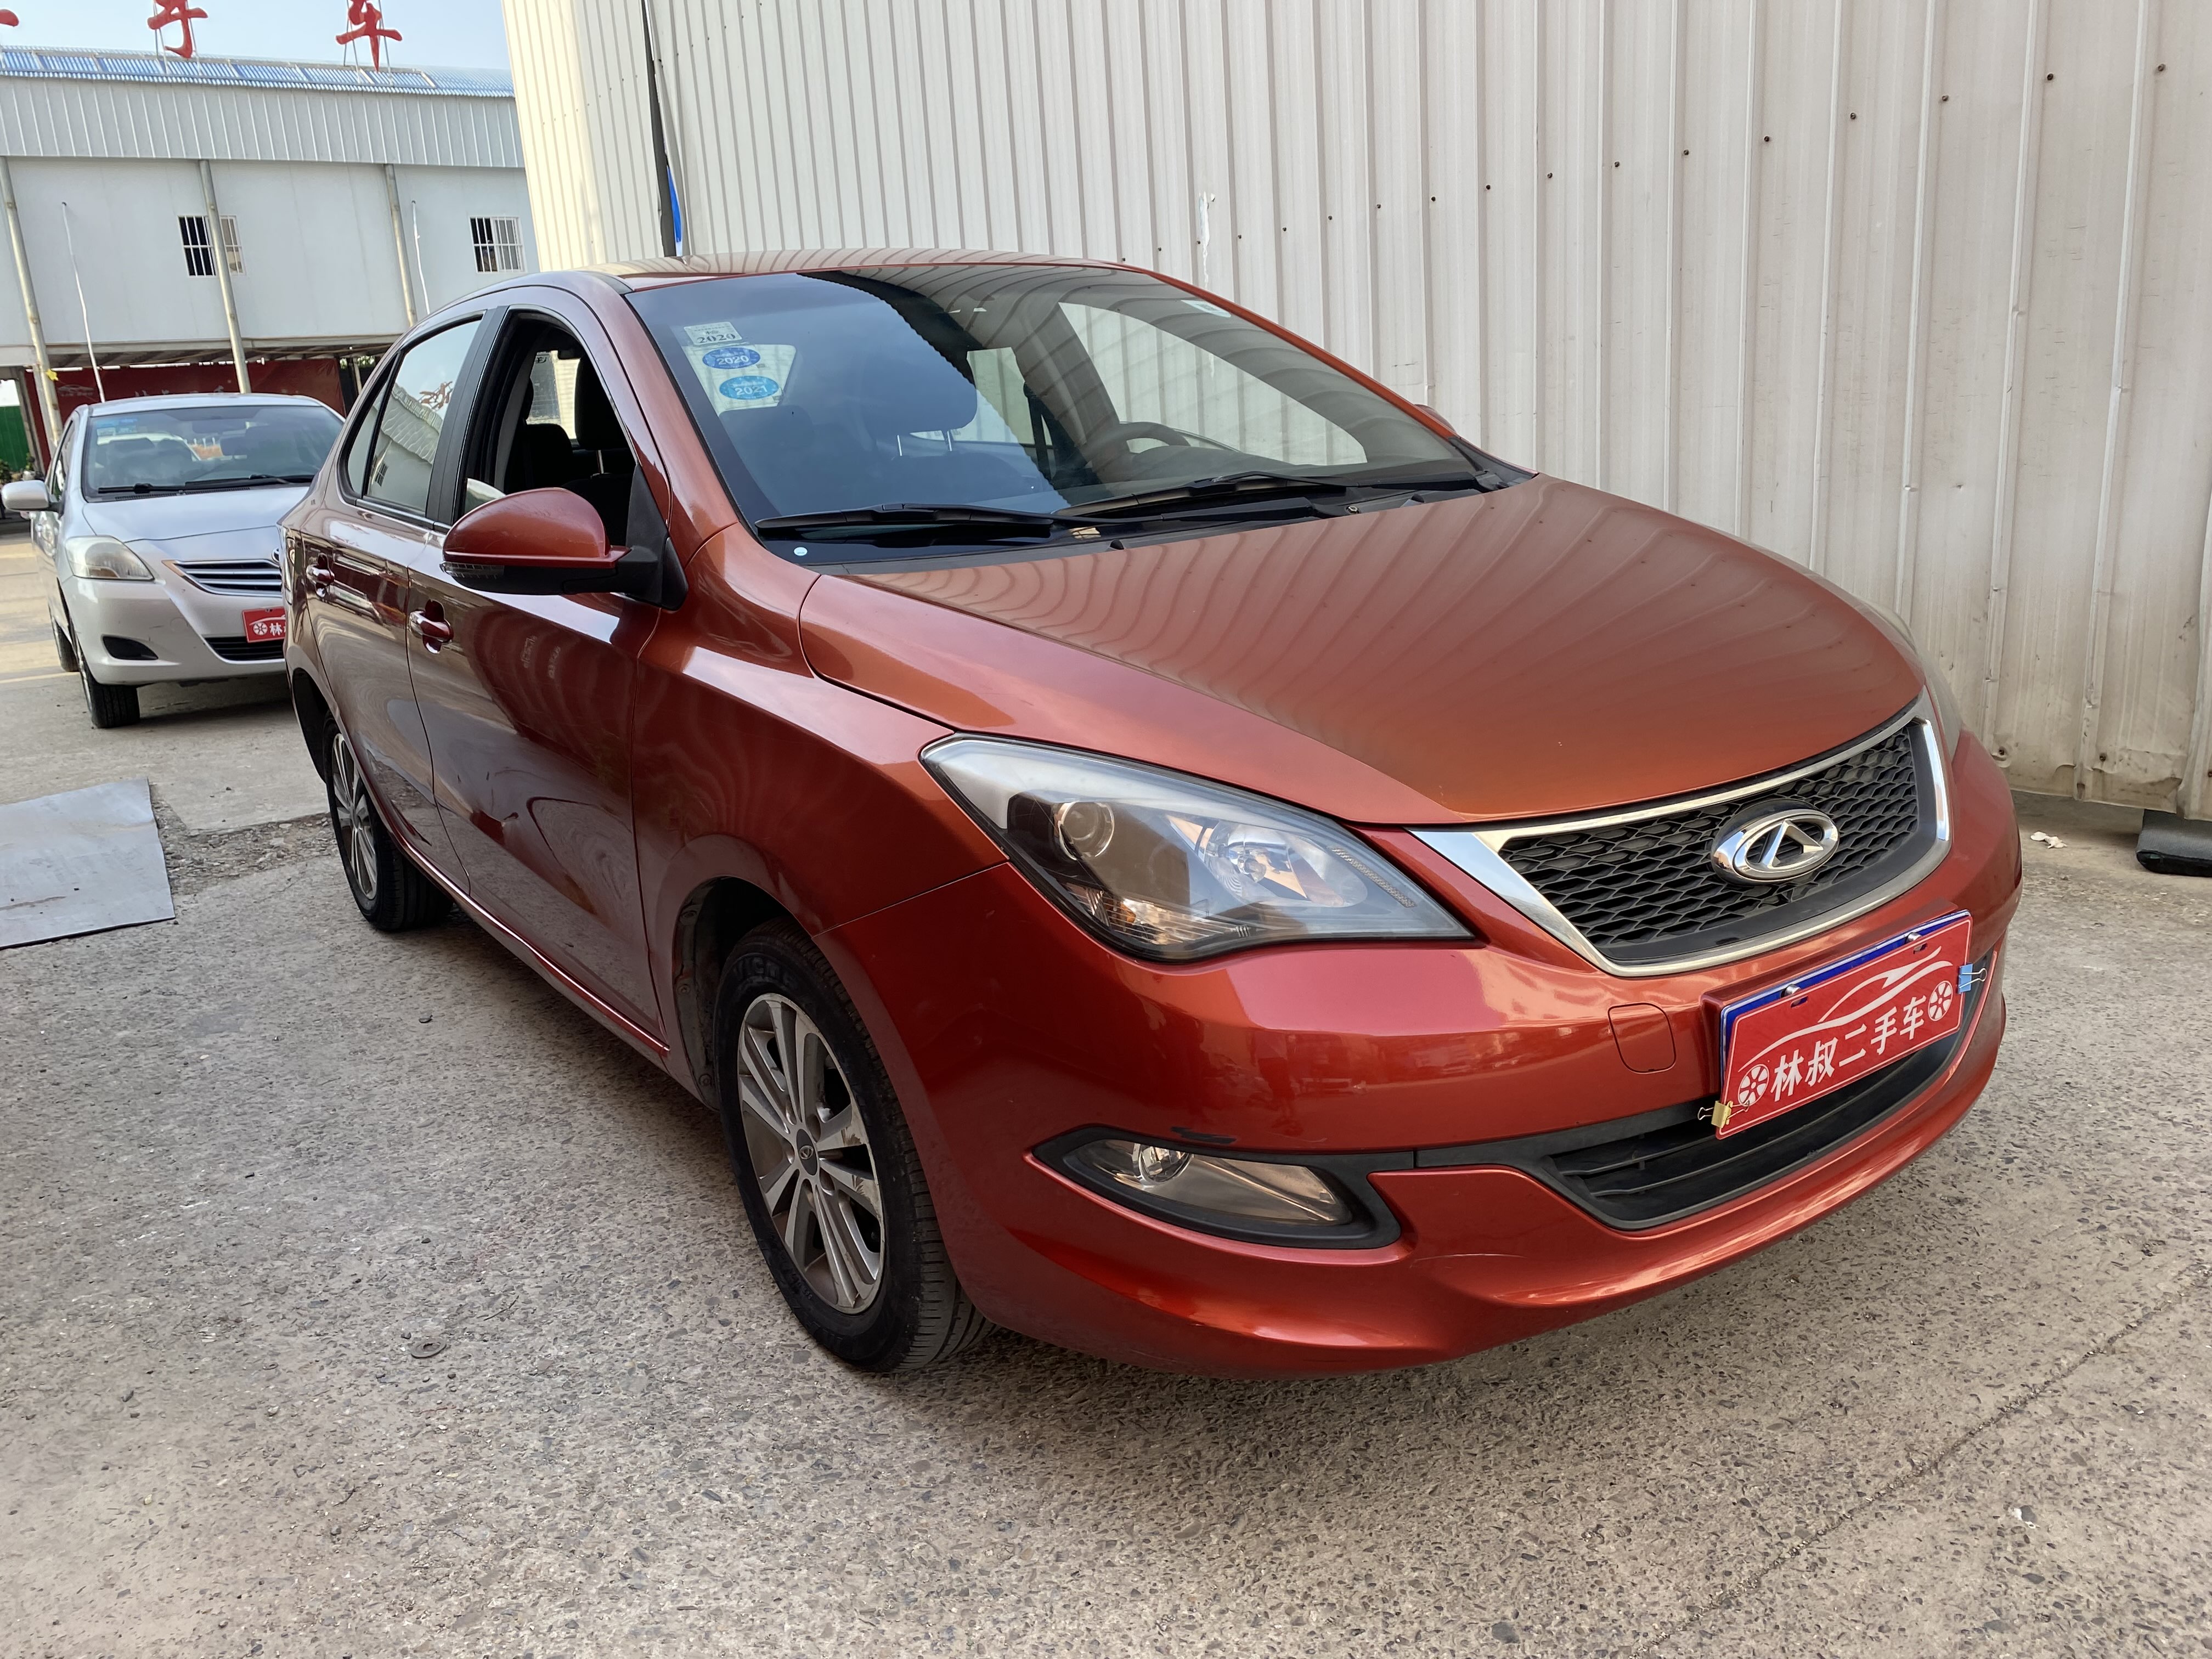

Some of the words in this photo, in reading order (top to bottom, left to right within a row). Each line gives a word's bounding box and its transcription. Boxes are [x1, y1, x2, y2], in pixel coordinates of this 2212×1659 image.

[697, 334, 735, 343] 2020
[716, 355, 749, 365] 2020
[735, 385, 768, 396] 2021
[269, 622, 285, 636] 林
[1770, 995, 1927, 1102] 林叔二手车
